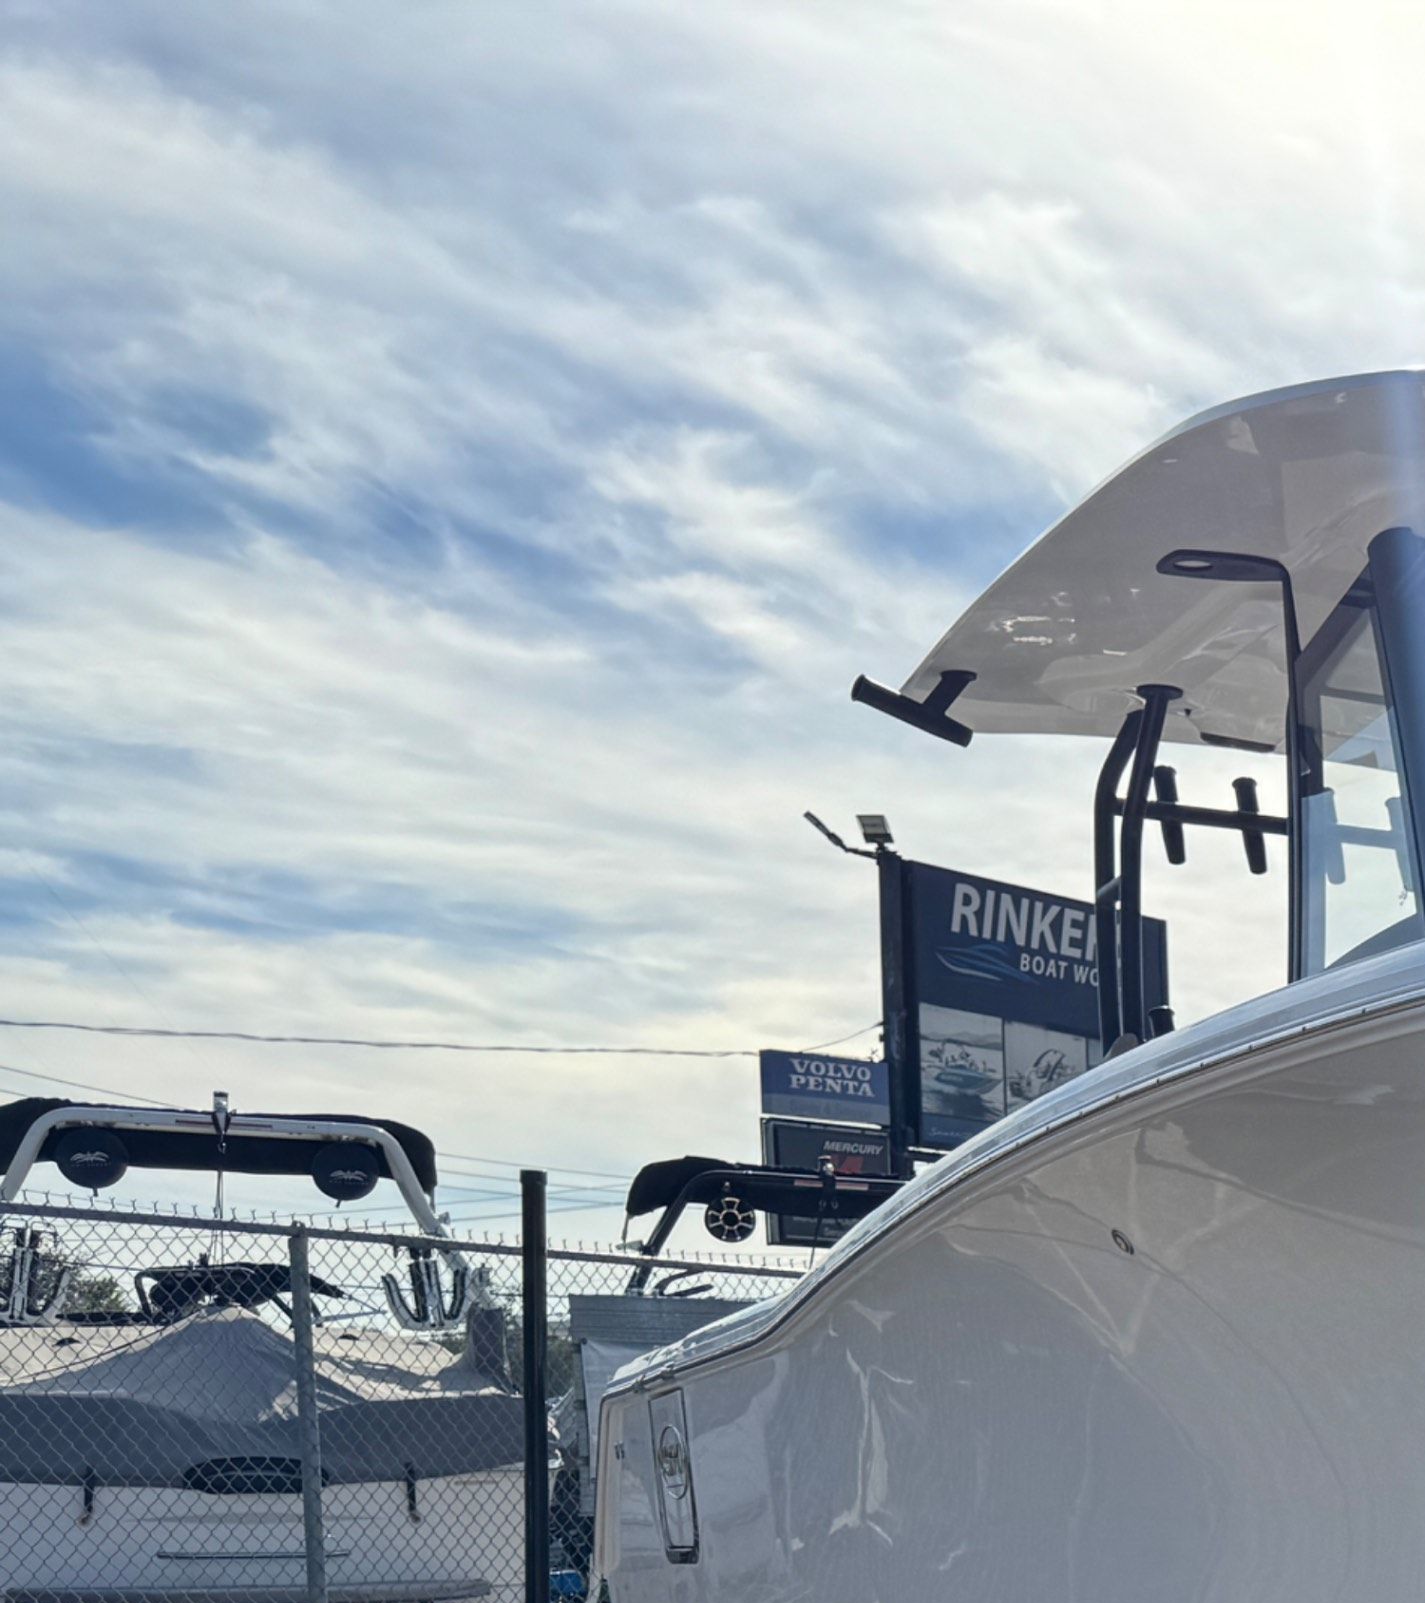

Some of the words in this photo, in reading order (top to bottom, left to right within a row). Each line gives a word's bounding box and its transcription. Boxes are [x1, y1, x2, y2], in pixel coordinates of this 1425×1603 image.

[1020, 953, 1068, 980] BOAT
[1073, 964, 1099, 987] WO
[790, 1058, 871, 1081] VOLVO
[789, 1074, 875, 1097] PENTA
[823, 1140, 883, 1155] MERCURY
